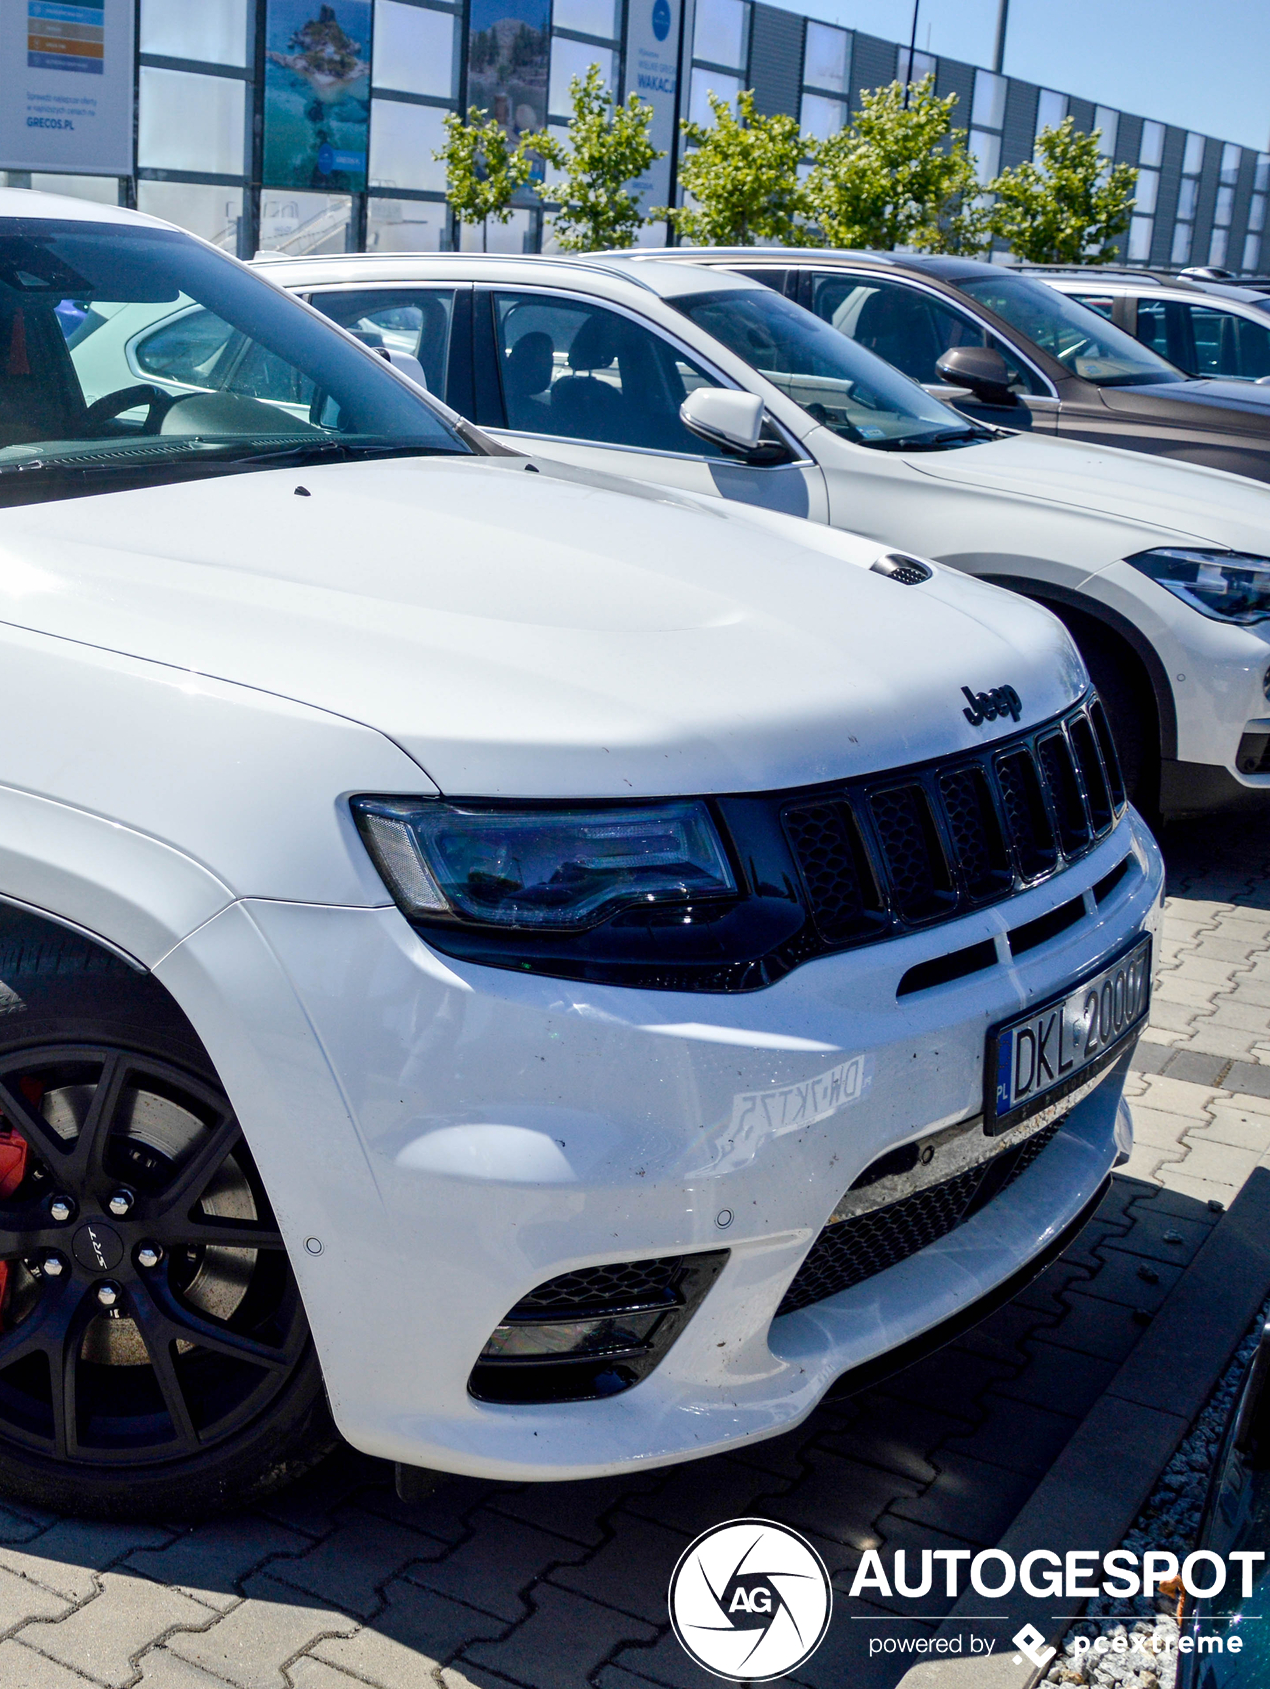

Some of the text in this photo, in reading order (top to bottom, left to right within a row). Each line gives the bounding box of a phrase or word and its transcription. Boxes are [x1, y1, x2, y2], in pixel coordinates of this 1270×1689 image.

[26, 116, 75, 131] GRECOS.PL
[960, 684, 1023, 727] Jeep
[1014, 1006, 1074, 1102] DKL
[1083, 949, 1148, 1060] 20007
[996, 1082, 1008, 1103] PL
[88, 1226, 108, 1269] SRT
